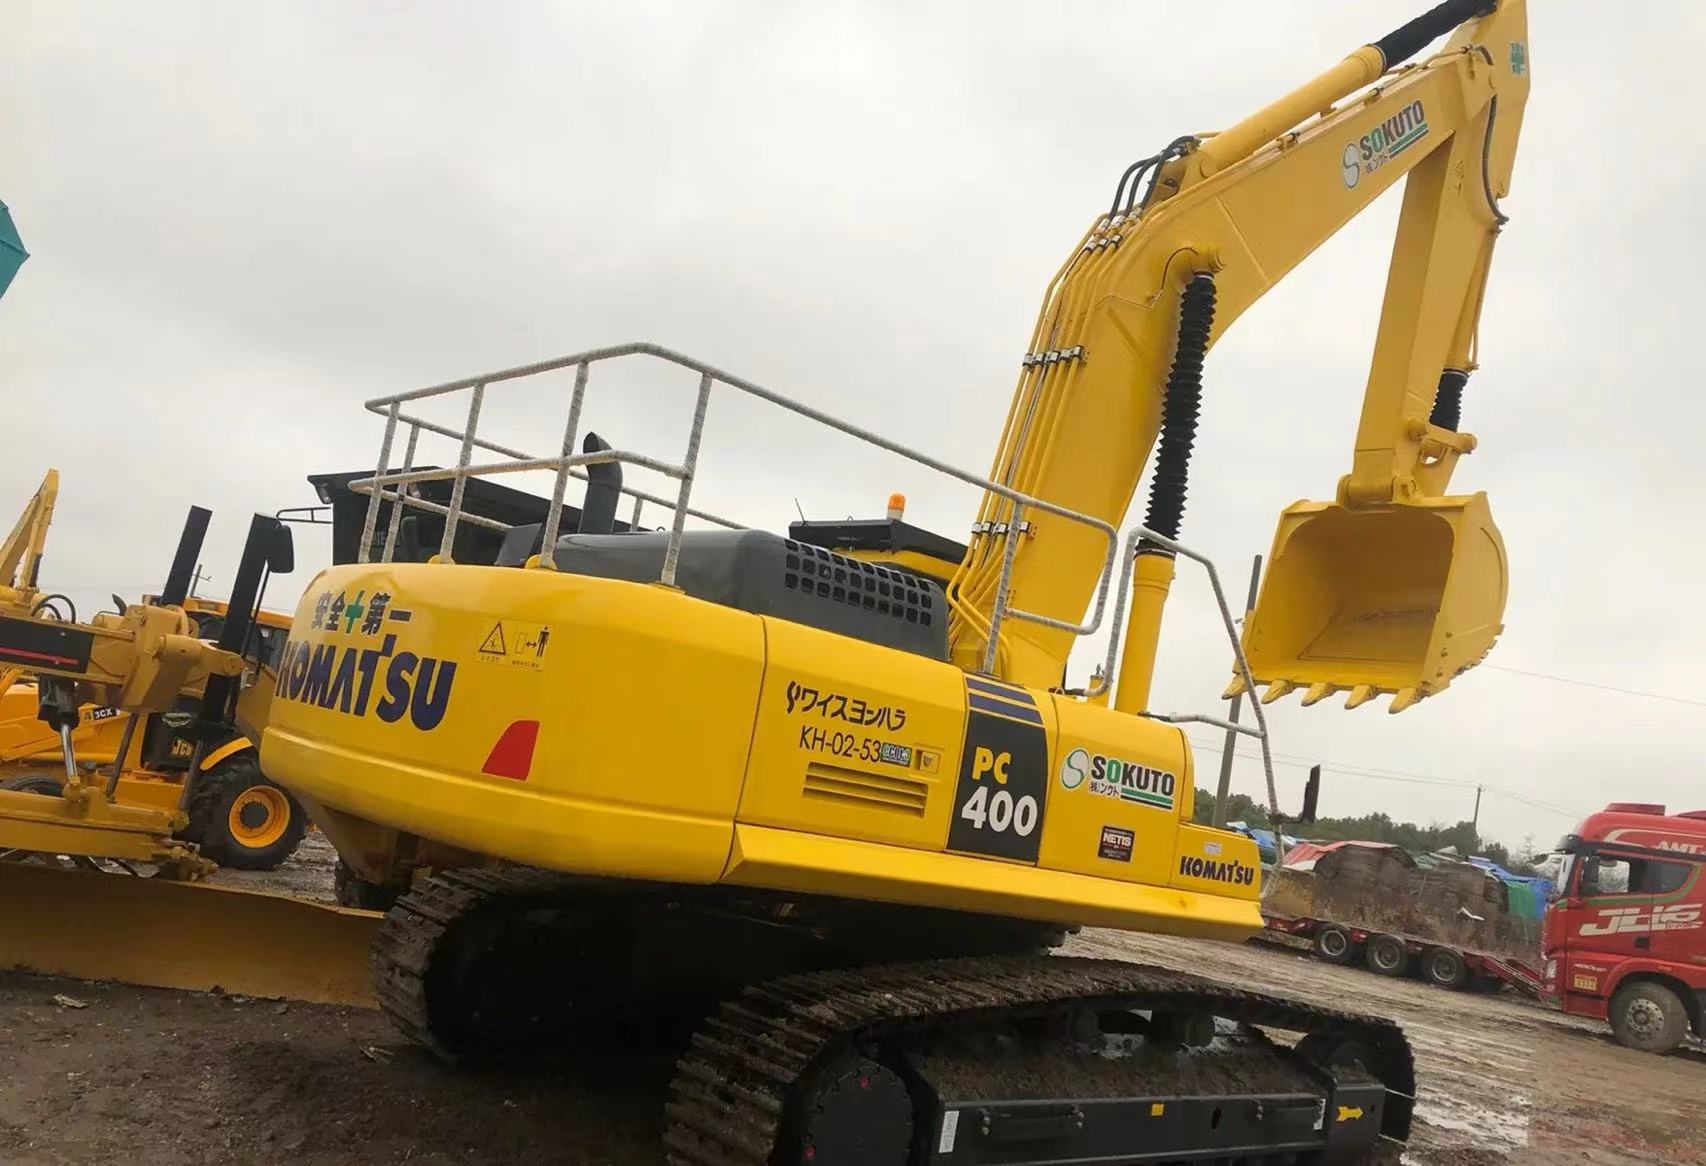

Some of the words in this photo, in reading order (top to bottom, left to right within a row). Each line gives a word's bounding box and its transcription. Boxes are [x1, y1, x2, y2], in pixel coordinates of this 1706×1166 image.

[1359, 100, 1425, 161] SOKUTO
[275, 633, 457, 731] KOMATSU
[94, 709, 113, 719] 3CX
[799, 724, 881, 763] KH-02-53
[971, 746, 1012, 785] PC
[1091, 755, 1176, 797] SOKUTO
[961, 786, 1038, 837] 400
[1102, 832, 1132, 847] NETIS
[1179, 855, 1255, 886] KOMATSU
